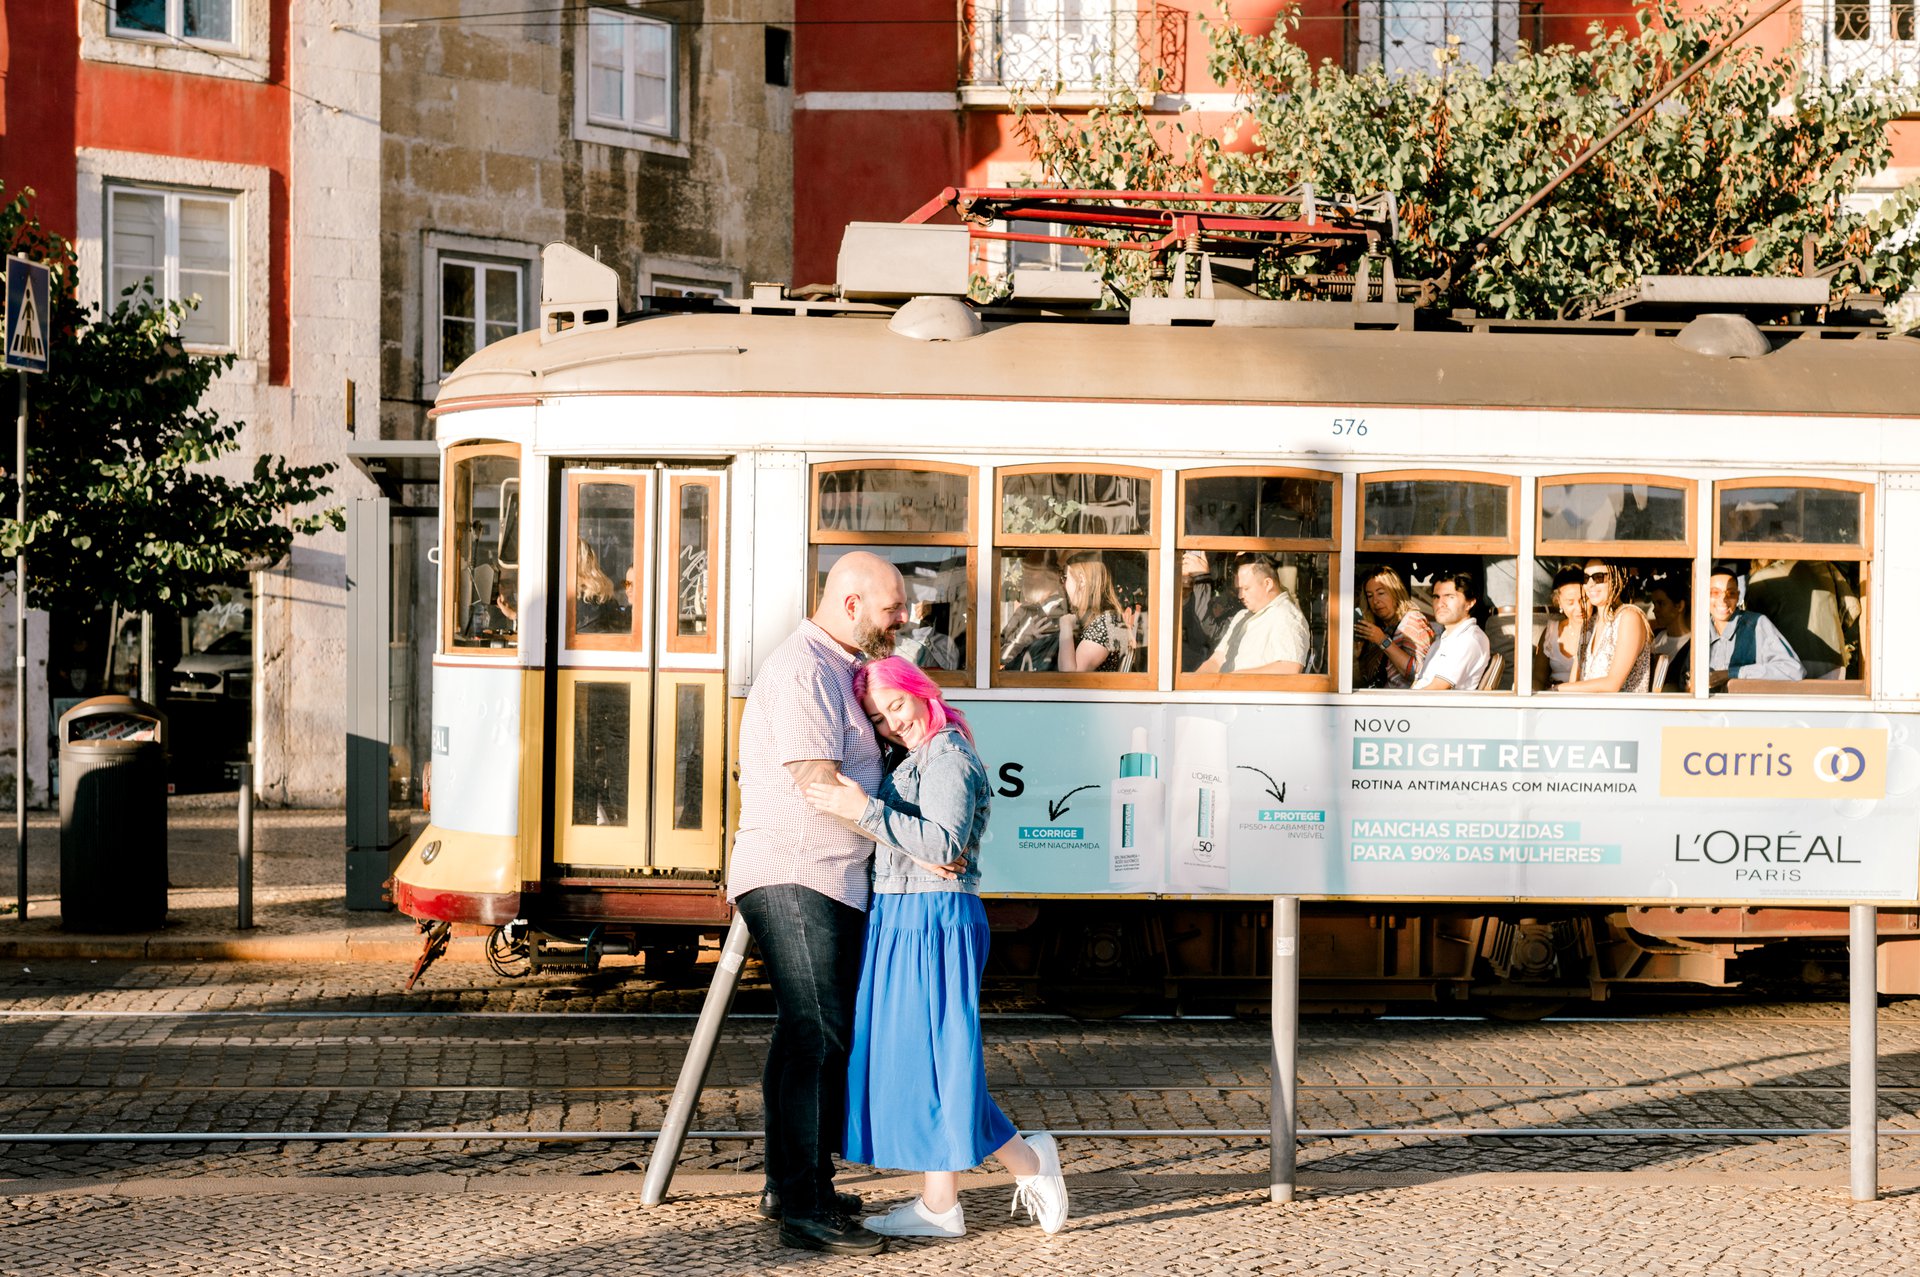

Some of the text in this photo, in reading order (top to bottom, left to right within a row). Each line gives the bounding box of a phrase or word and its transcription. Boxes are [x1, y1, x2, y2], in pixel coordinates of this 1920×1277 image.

[1332, 418, 1368, 436] 576
[1353, 718, 1411, 733] NOVO
[1359, 742, 1631, 769] BRIGHT REVEAL
[1683, 742, 1793, 777] carris
[1351, 779, 1638, 794] ROTINA ANTIMANCHAS COM NIACINAMIDA
[1263, 812, 1321, 821] 2. PROTEGE
[1024, 829, 1078, 838] 1. CORRIGE
[1353, 821, 1565, 840] MANCHAS REDUZIDAS
[1019, 841, 1100, 850] SÉRUM NIACINAMIDA
[1353, 845, 1406, 861] PARA
[1411, 846, 1451, 862] 90%
[1456, 847, 1494, 863] DAS
[1675, 830, 1862, 864] L'ORÉAL
